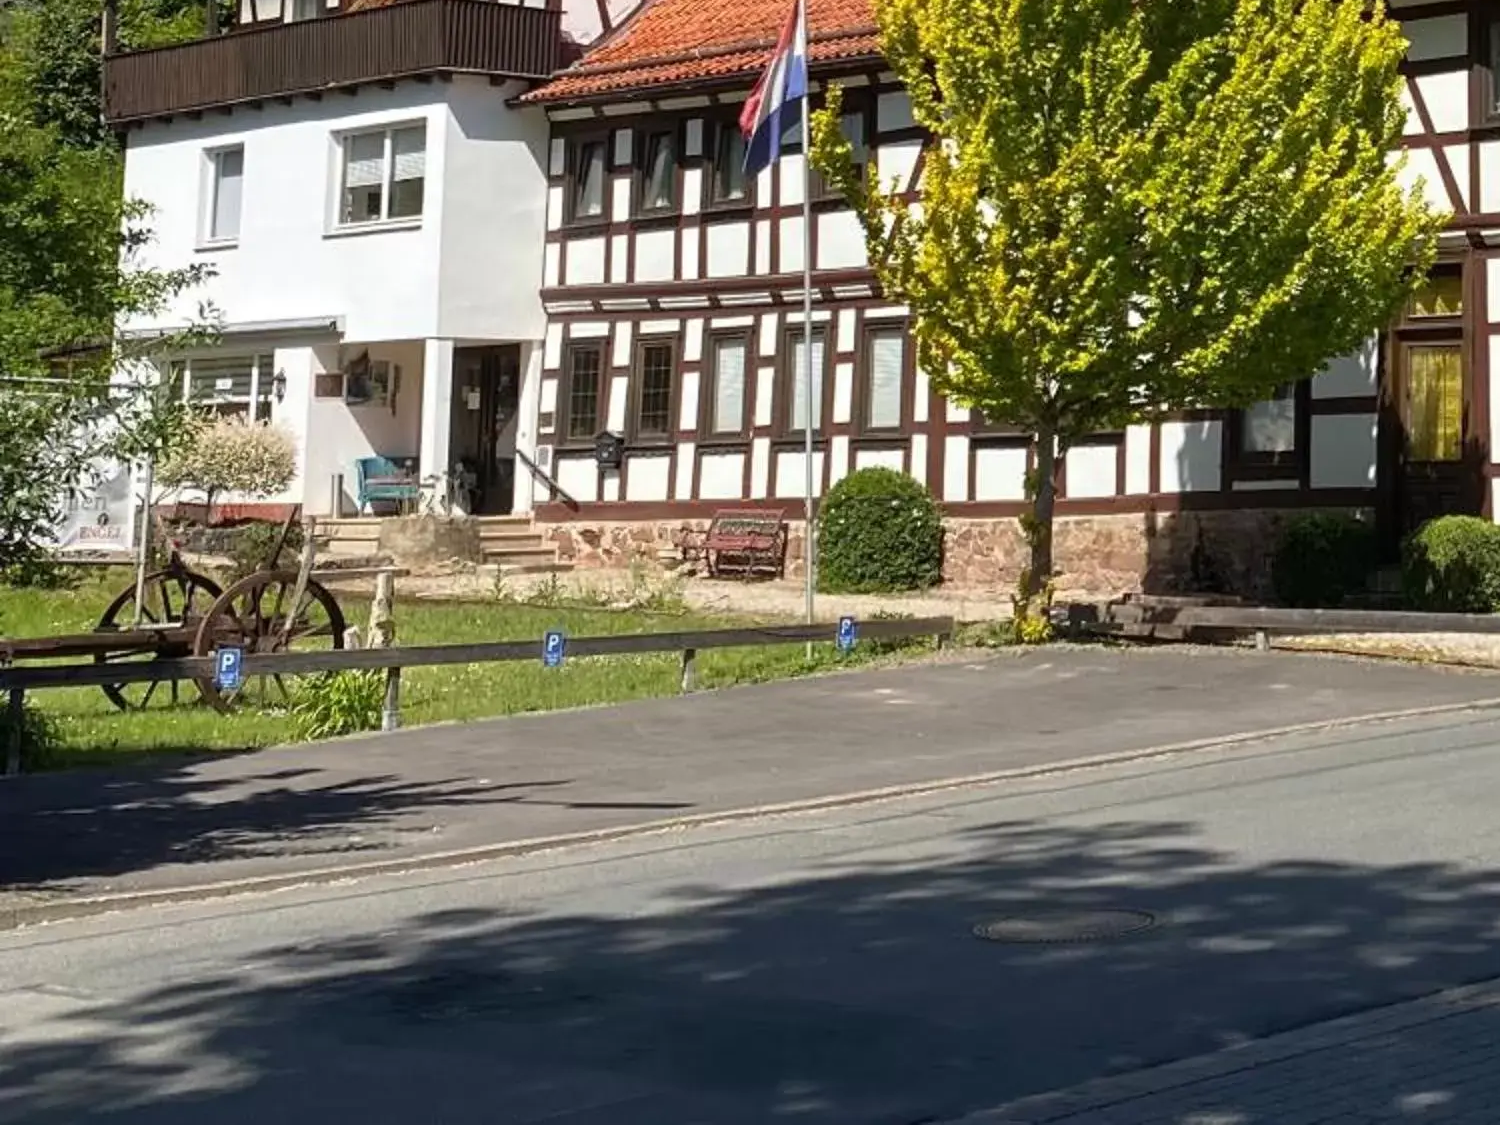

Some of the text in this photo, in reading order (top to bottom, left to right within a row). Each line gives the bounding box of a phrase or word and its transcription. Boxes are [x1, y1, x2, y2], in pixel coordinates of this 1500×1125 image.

[841, 618, 852, 635] P
[547, 634, 559, 652] P
[221, 654, 235, 672] P
